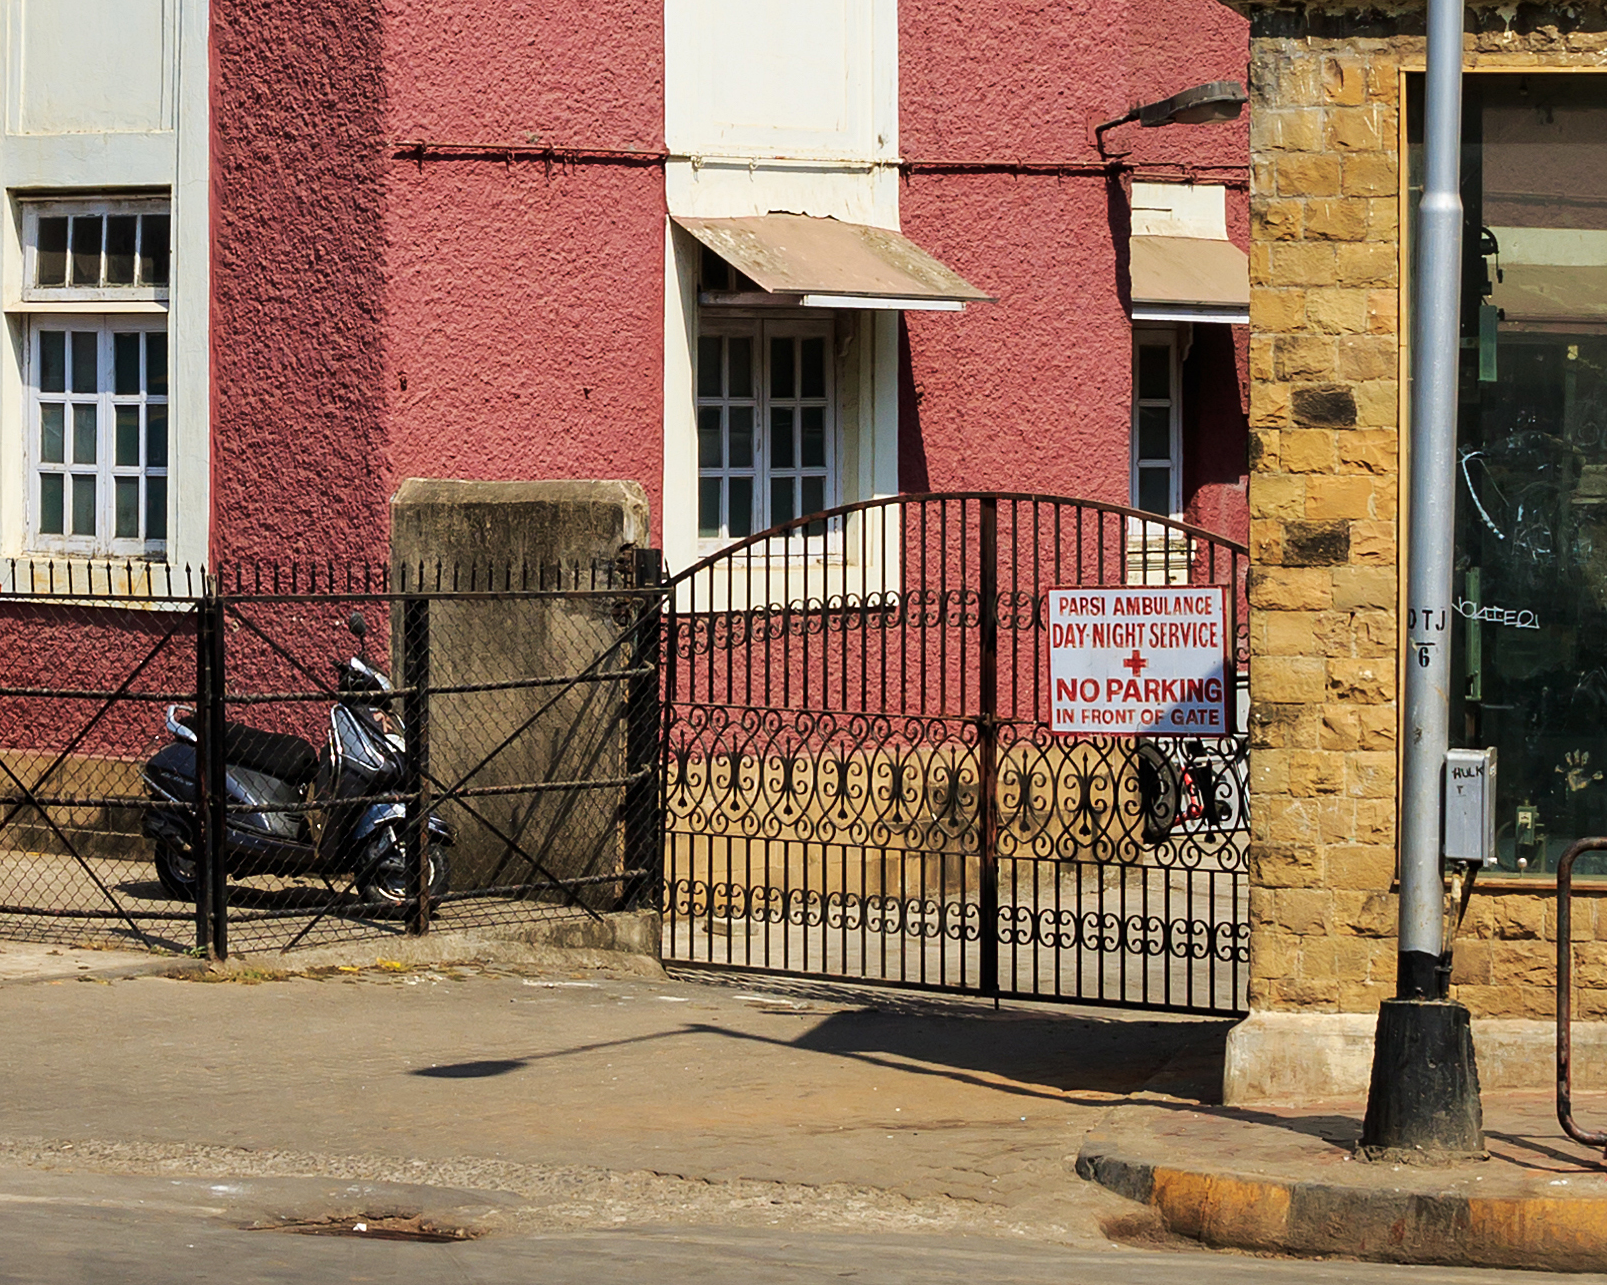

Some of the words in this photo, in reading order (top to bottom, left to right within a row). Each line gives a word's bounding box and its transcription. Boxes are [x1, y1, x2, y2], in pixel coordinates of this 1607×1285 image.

[1059, 596, 1105, 616] PARSI
[1113, 596, 1212, 616] AMBULANCE
[1149, 623, 1218, 648] SERVICE
[1418, 646, 1430, 667] 6
[1056, 678, 1100, 703] NO
[1106, 678, 1222, 703] PARKING
[1056, 709, 1074, 724] IN
[1082, 709, 1135, 724] FRONT
[1141, 709, 1164, 725] OF
[1171, 709, 1219, 725] GATE
